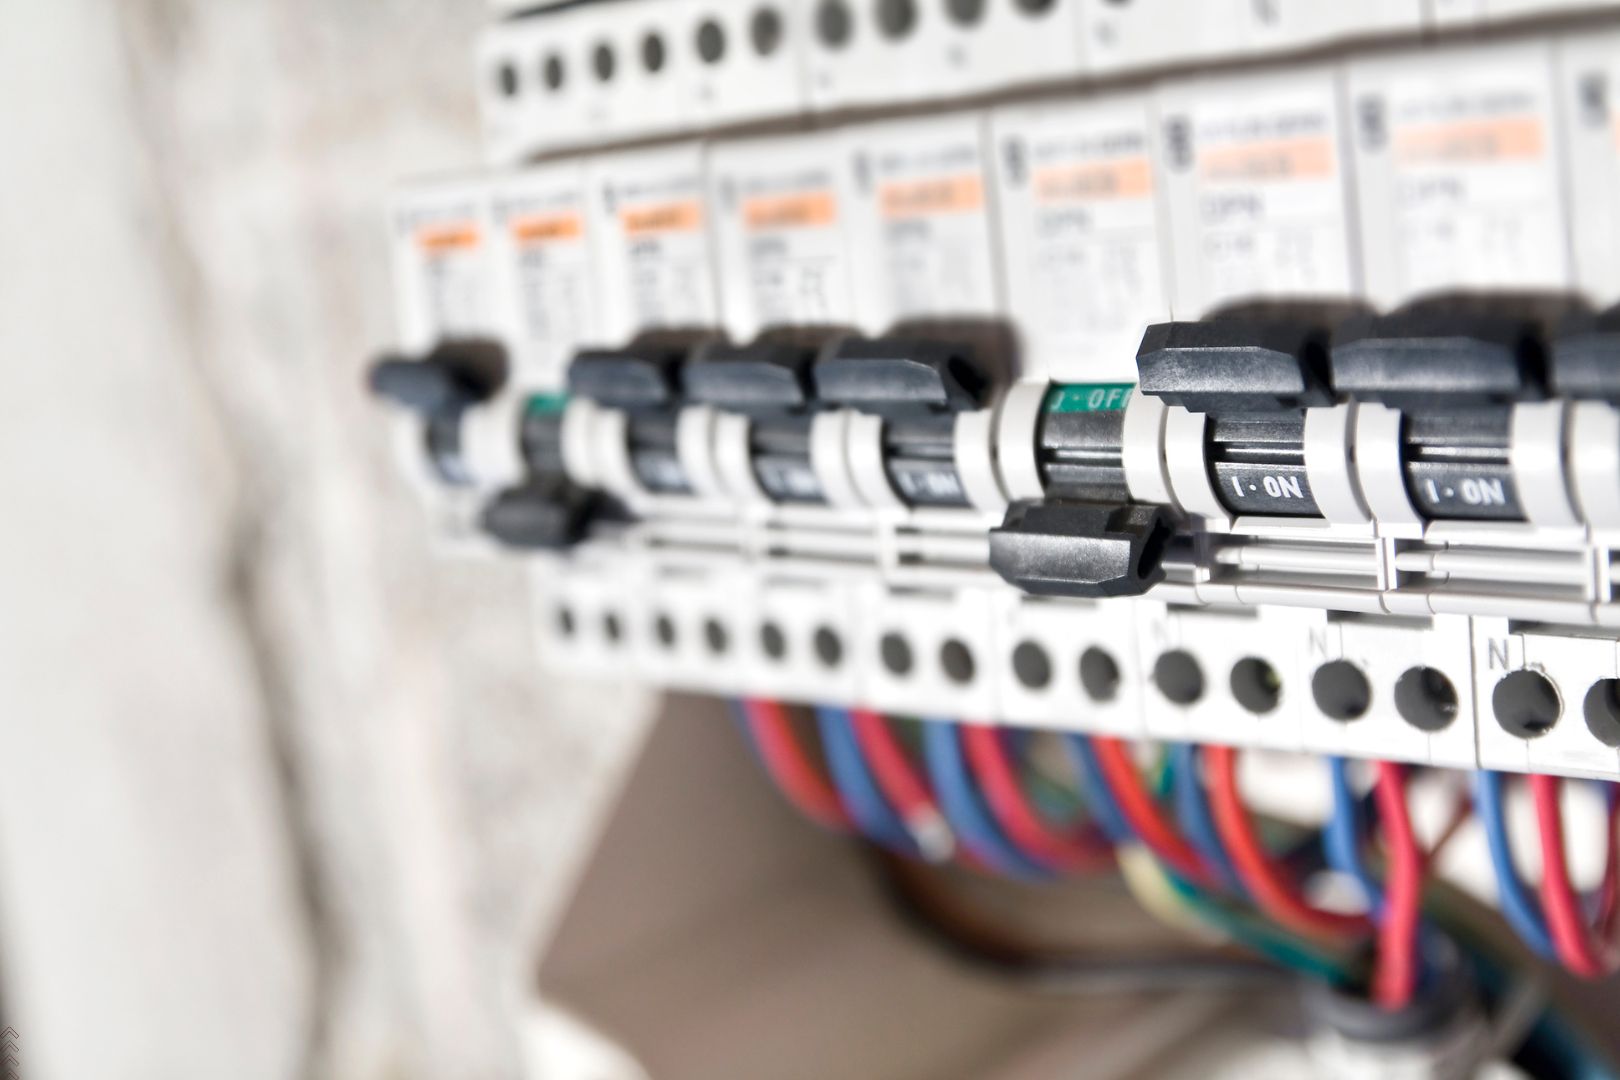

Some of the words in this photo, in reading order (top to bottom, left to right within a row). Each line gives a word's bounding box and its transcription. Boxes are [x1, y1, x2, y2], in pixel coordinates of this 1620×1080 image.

[1231, 475, 1245, 497] I
[1262, 475, 1304, 498] ON
[1425, 478, 1440, 503] I
[1460, 477, 1506, 505] ON
[1487, 637, 1509, 670] N
